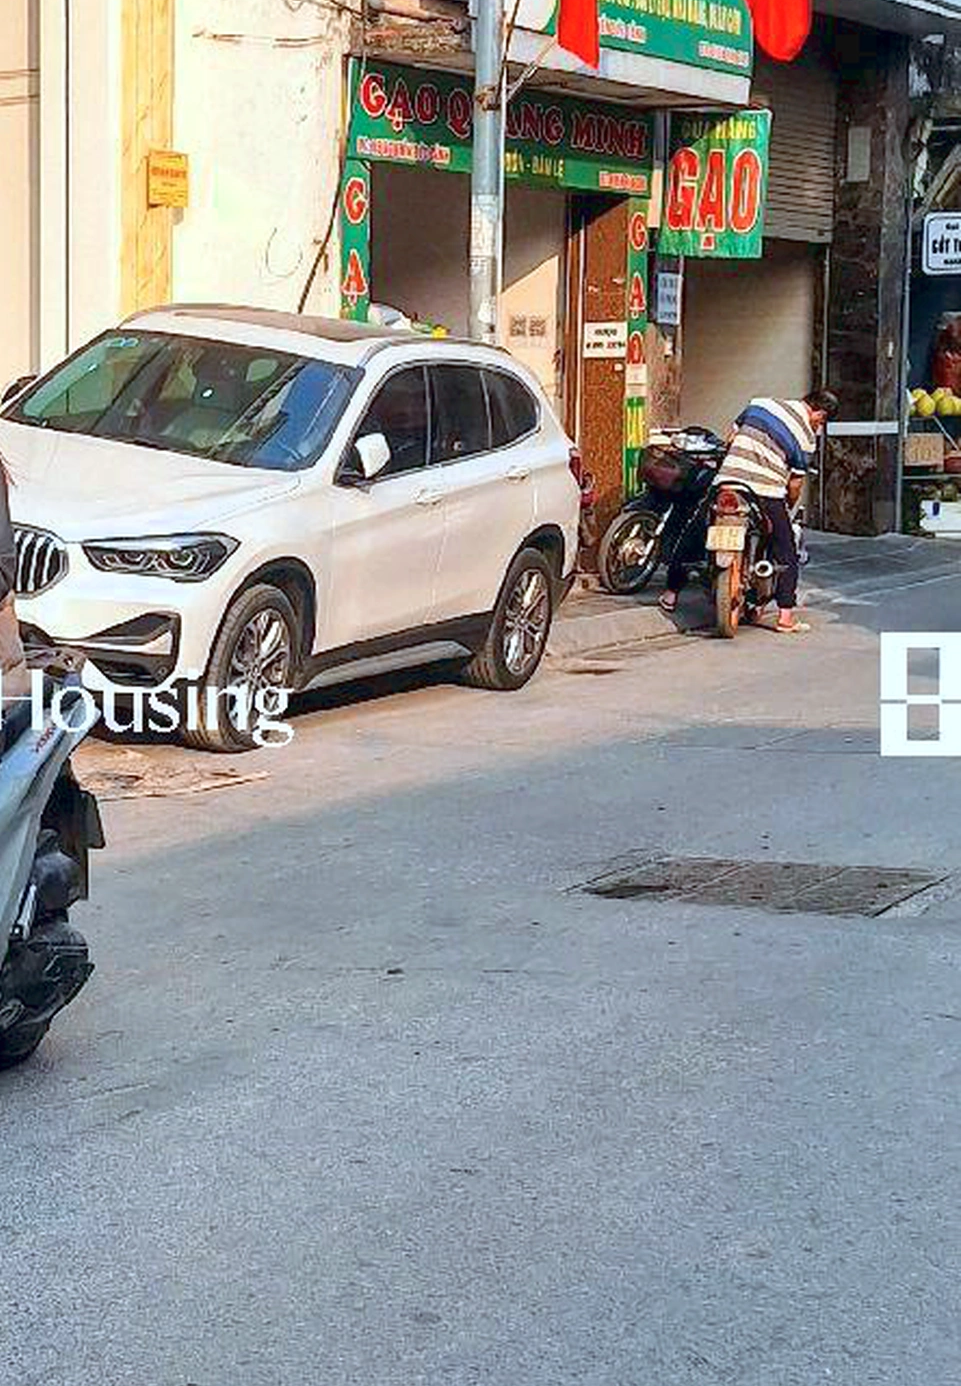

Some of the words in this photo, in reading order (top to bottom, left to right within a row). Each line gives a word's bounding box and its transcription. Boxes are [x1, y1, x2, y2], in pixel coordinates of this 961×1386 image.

[360, 73, 439, 132] GẠO
[447, 88, 564, 144] QANG
[570, 111, 647, 159] MINH
[667, 146, 762, 250] GẠO
